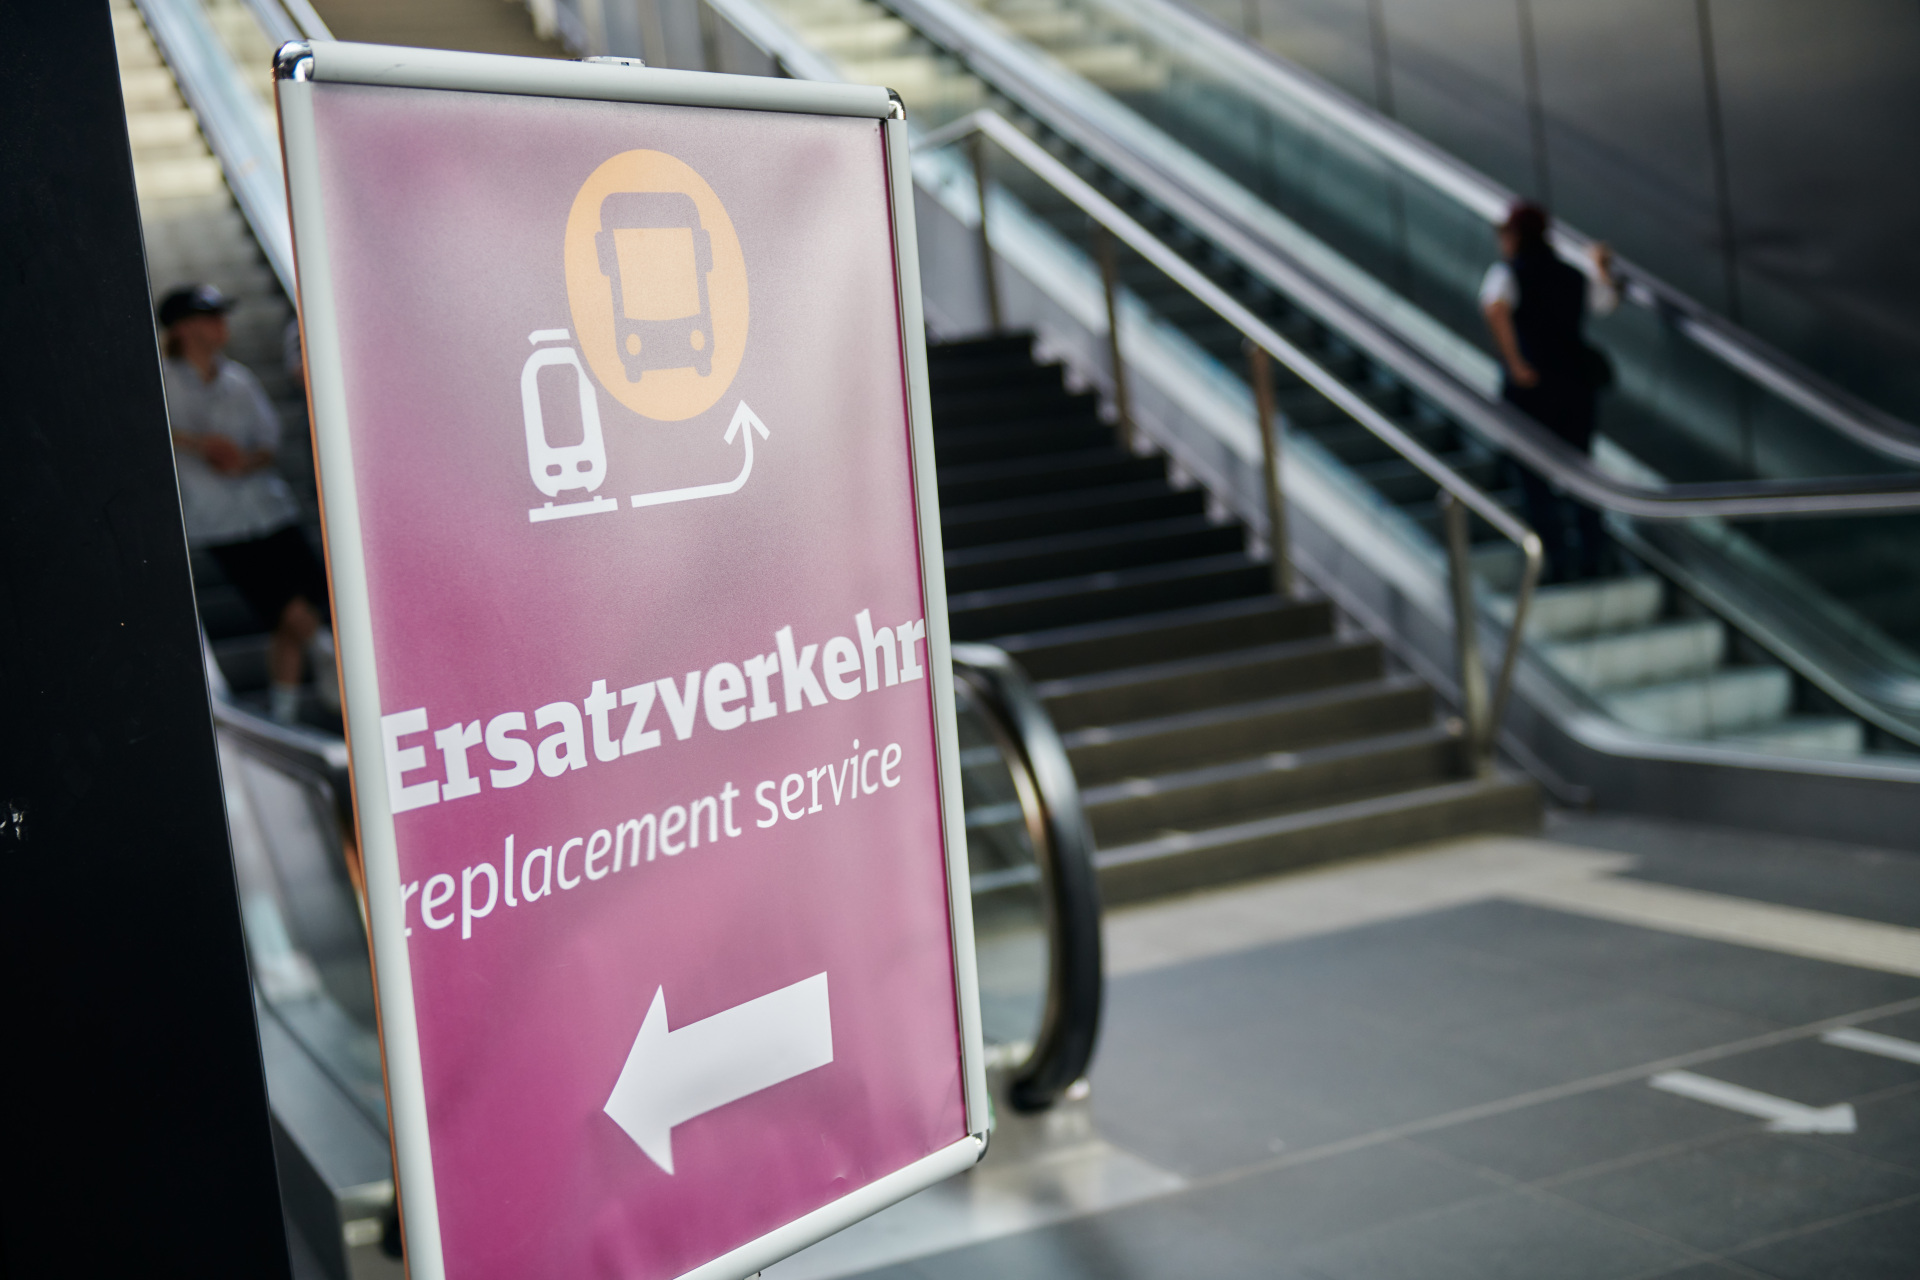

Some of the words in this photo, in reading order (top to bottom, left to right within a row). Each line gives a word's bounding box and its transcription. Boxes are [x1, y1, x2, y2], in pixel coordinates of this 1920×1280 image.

[380, 608, 925, 814] Ersatzverkehr
[400, 781, 742, 939] replacement
[754, 738, 902, 828] service
